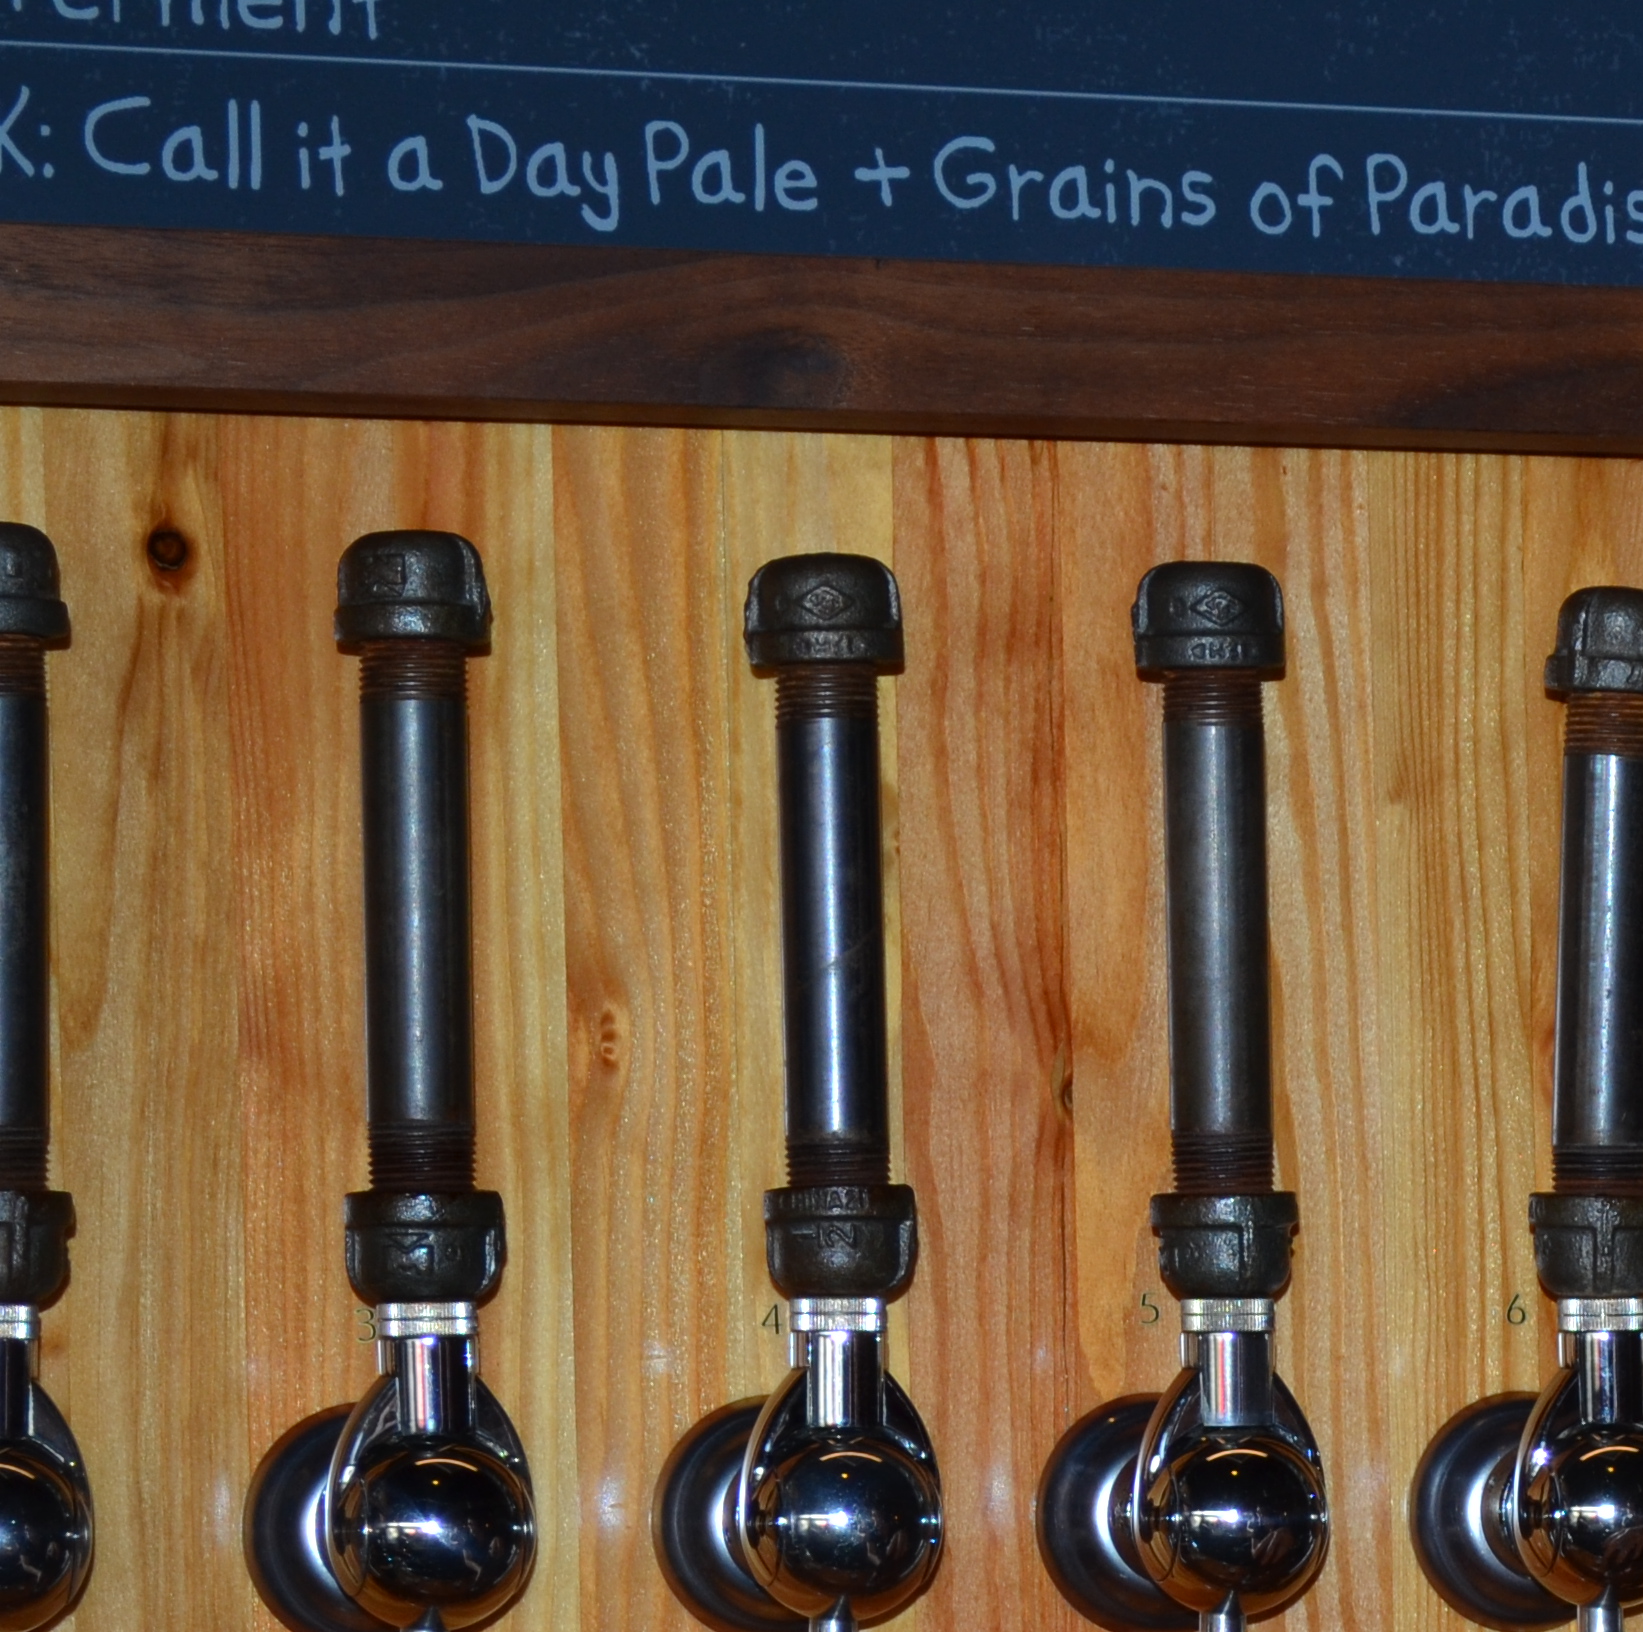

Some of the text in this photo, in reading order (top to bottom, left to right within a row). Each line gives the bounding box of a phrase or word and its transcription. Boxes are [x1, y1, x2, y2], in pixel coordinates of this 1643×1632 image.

[85, 97, 261, 190] Call
[298, 116, 351, 196] it
[388, 136, 443, 191] a
[467, 114, 619, 231] Day
[645, 121, 818, 211] Pale
[934, 136, 1216, 228] Grains
[1250, 154, 1343, 237] of
[354, 1307, 377, 1343] 3
[761, 1304, 783, 1338] 4
[1139, 1292, 1161, 1325] 5
[1505, 1294, 1528, 1326] 6
